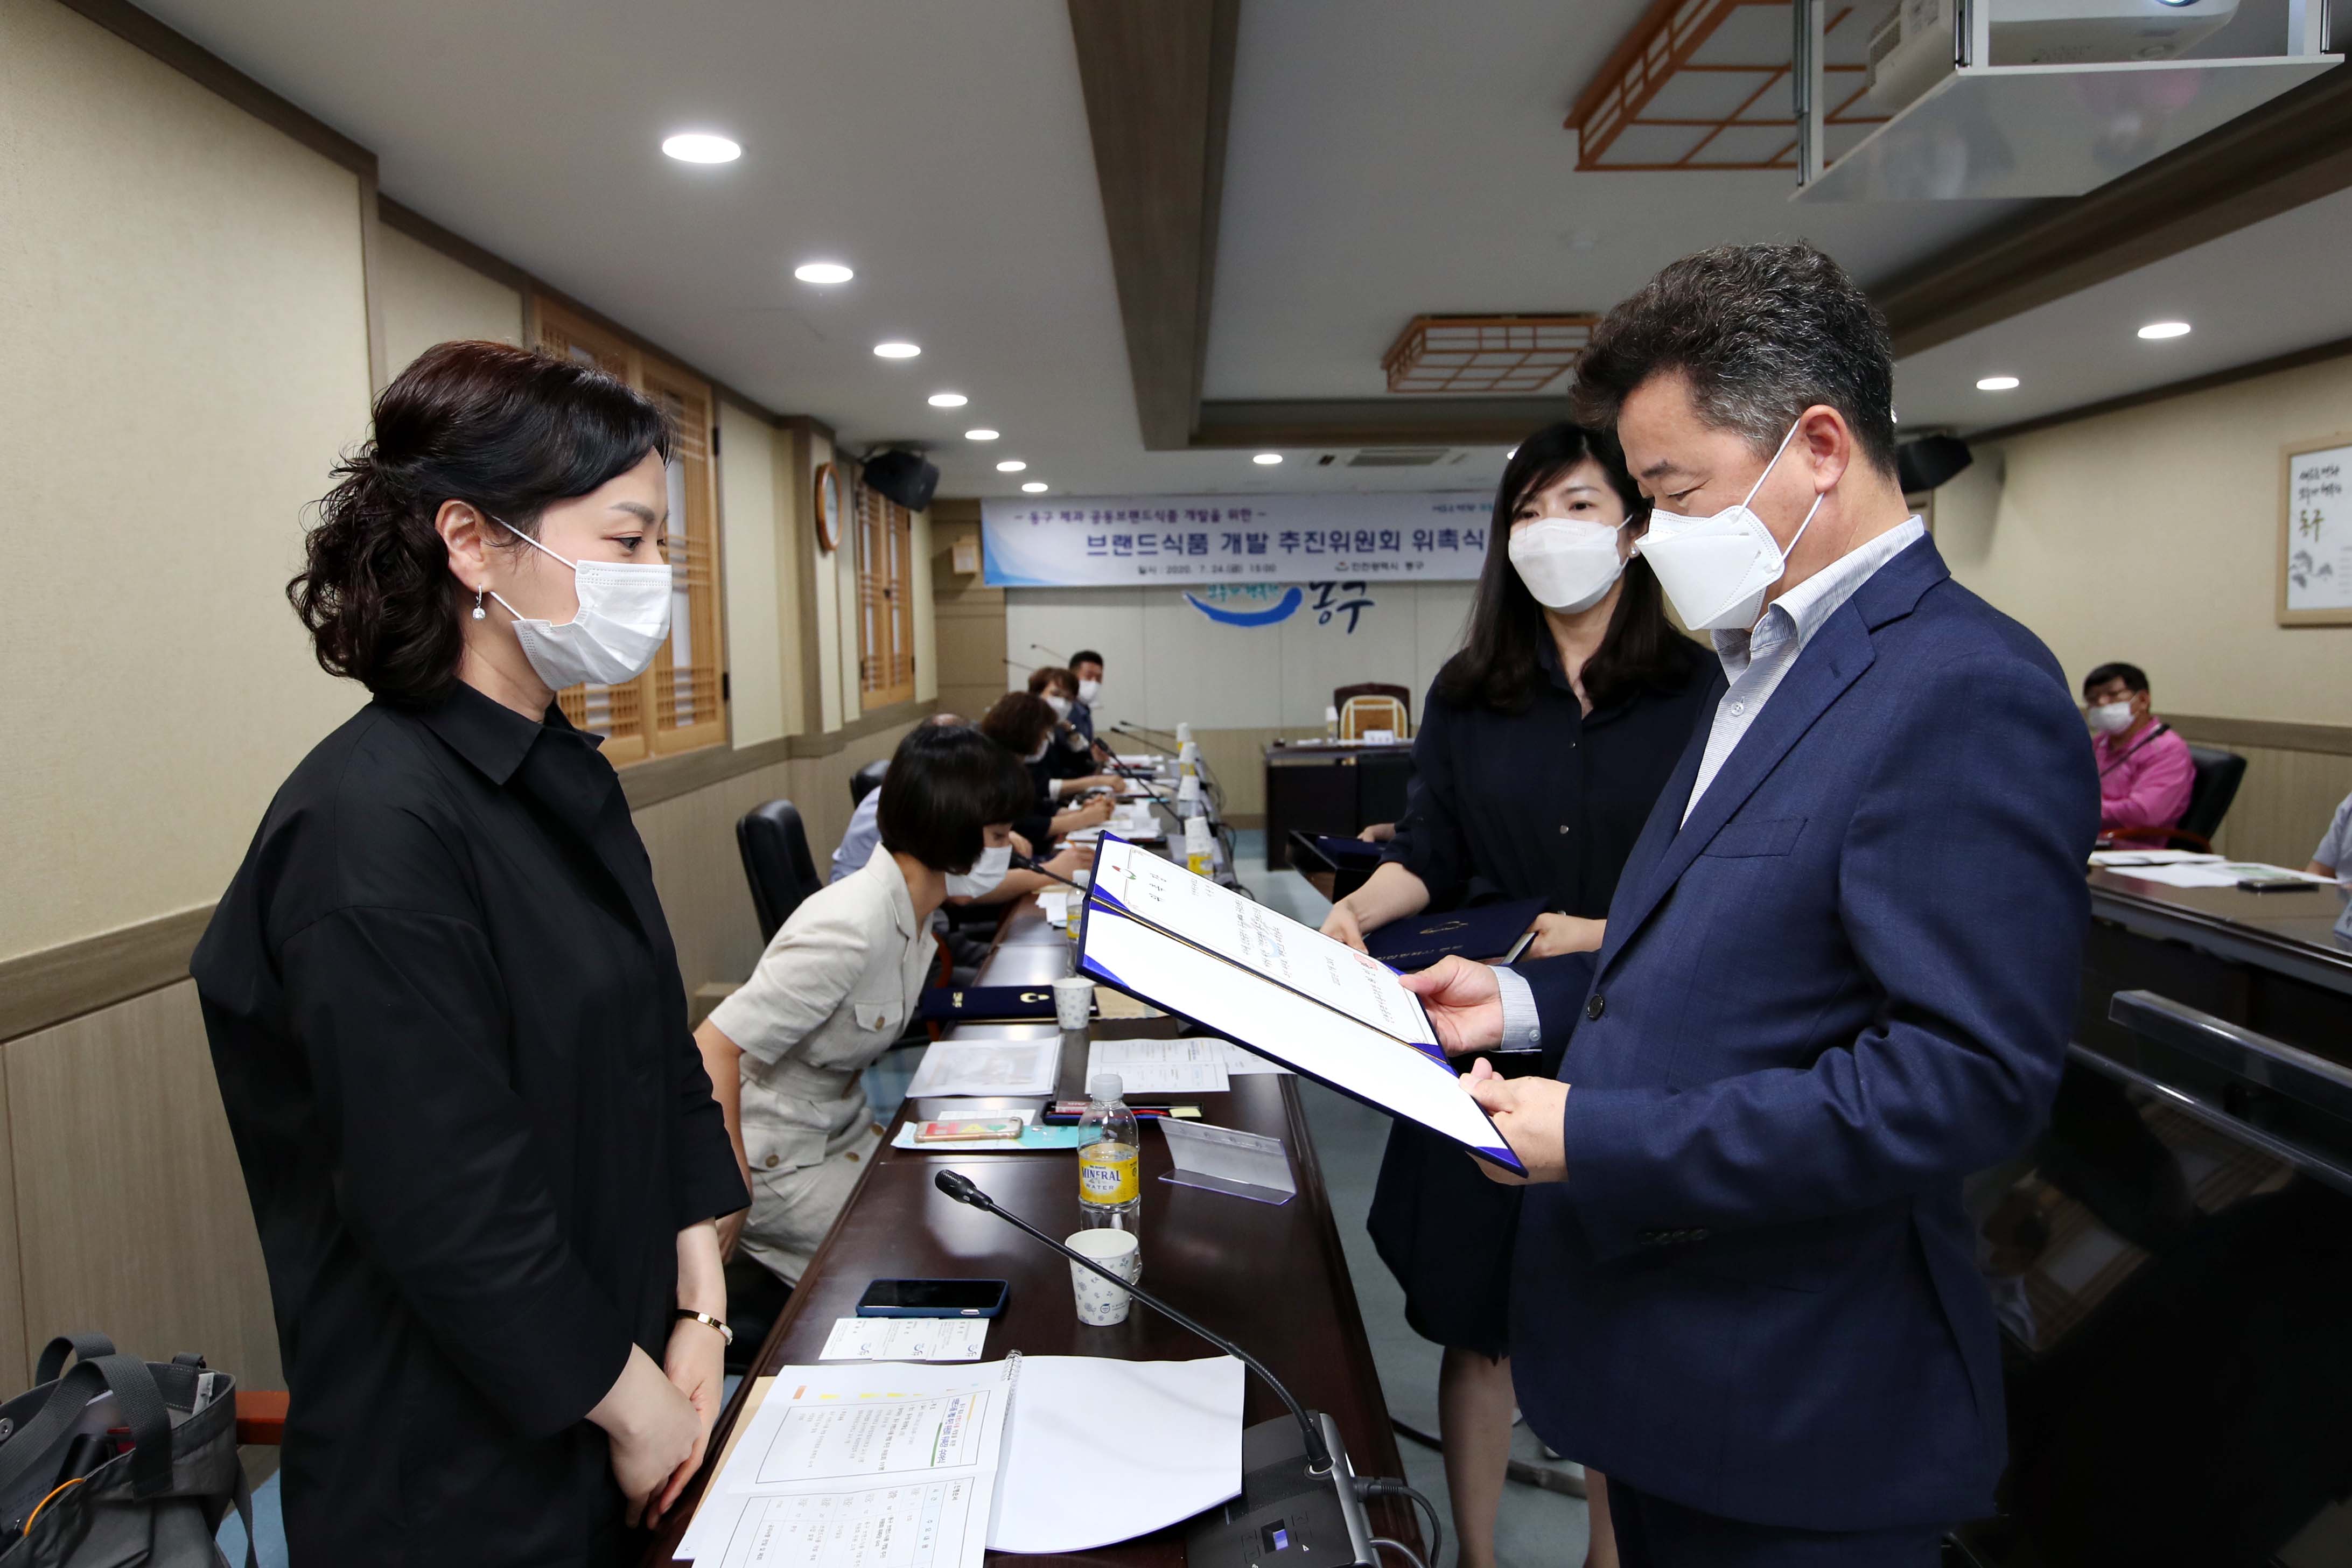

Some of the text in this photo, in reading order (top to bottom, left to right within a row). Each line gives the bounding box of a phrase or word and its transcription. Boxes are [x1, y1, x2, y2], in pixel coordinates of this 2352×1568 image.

[1030, 511, 1053, 526] 동구
[1186, 509, 1220, 523] 개발을
[1228, 508, 1252, 522] 위한
[1087, 527, 1485, 556] 브랜드식품 개발 추진위원회 위촉식
[1081, 1166, 1122, 1182] MINERAL
[1085, 1182, 1115, 1191] WATER
